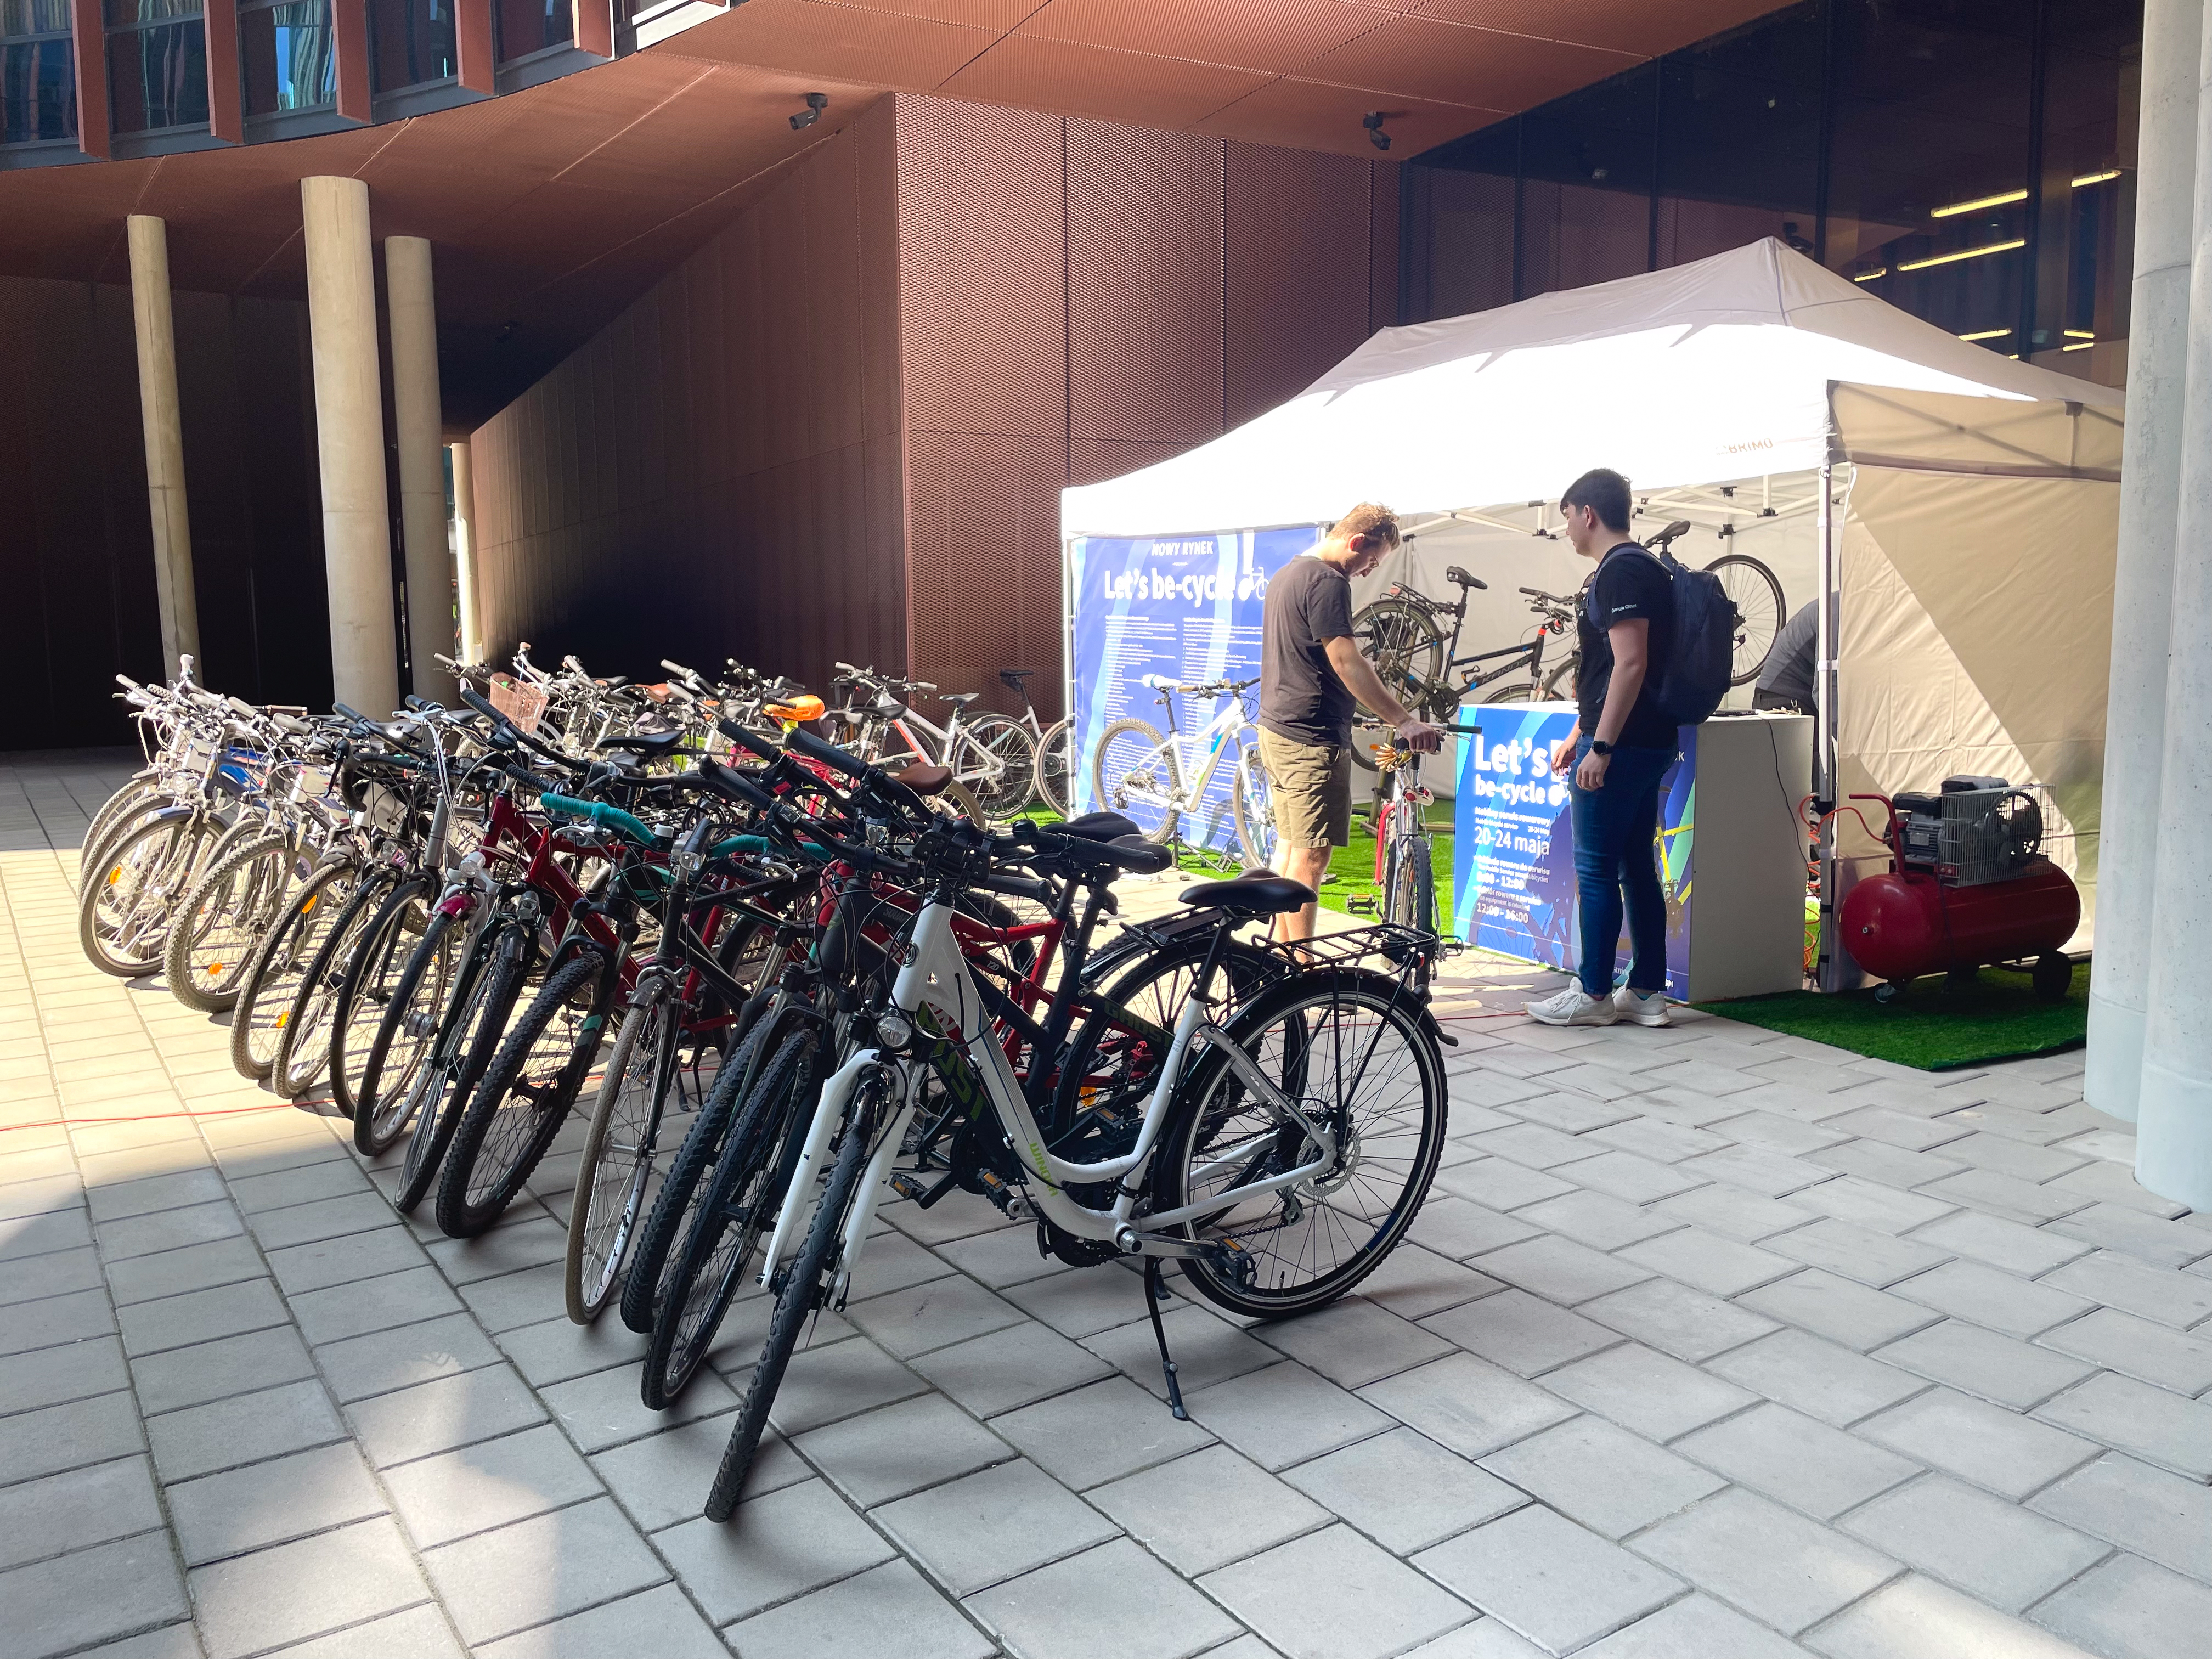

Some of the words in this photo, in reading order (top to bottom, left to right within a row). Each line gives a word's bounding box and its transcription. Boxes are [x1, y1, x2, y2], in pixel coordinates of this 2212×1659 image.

[1152, 543, 1181, 556] NOWY
[1182, 541, 1214, 556] RYNEK
[1104, 568, 1149, 600] Let's
[1476, 735, 1548, 777] Let's
[1475, 826, 1511, 849] 20-24
[1515, 835, 1550, 859] maja
[1501, 876, 1525, 890] 12:00
[1477, 902, 1499, 917] 12:00
[1505, 909, 1529, 923] 16:00
[1104, 998, 1175, 1048] GHOST
